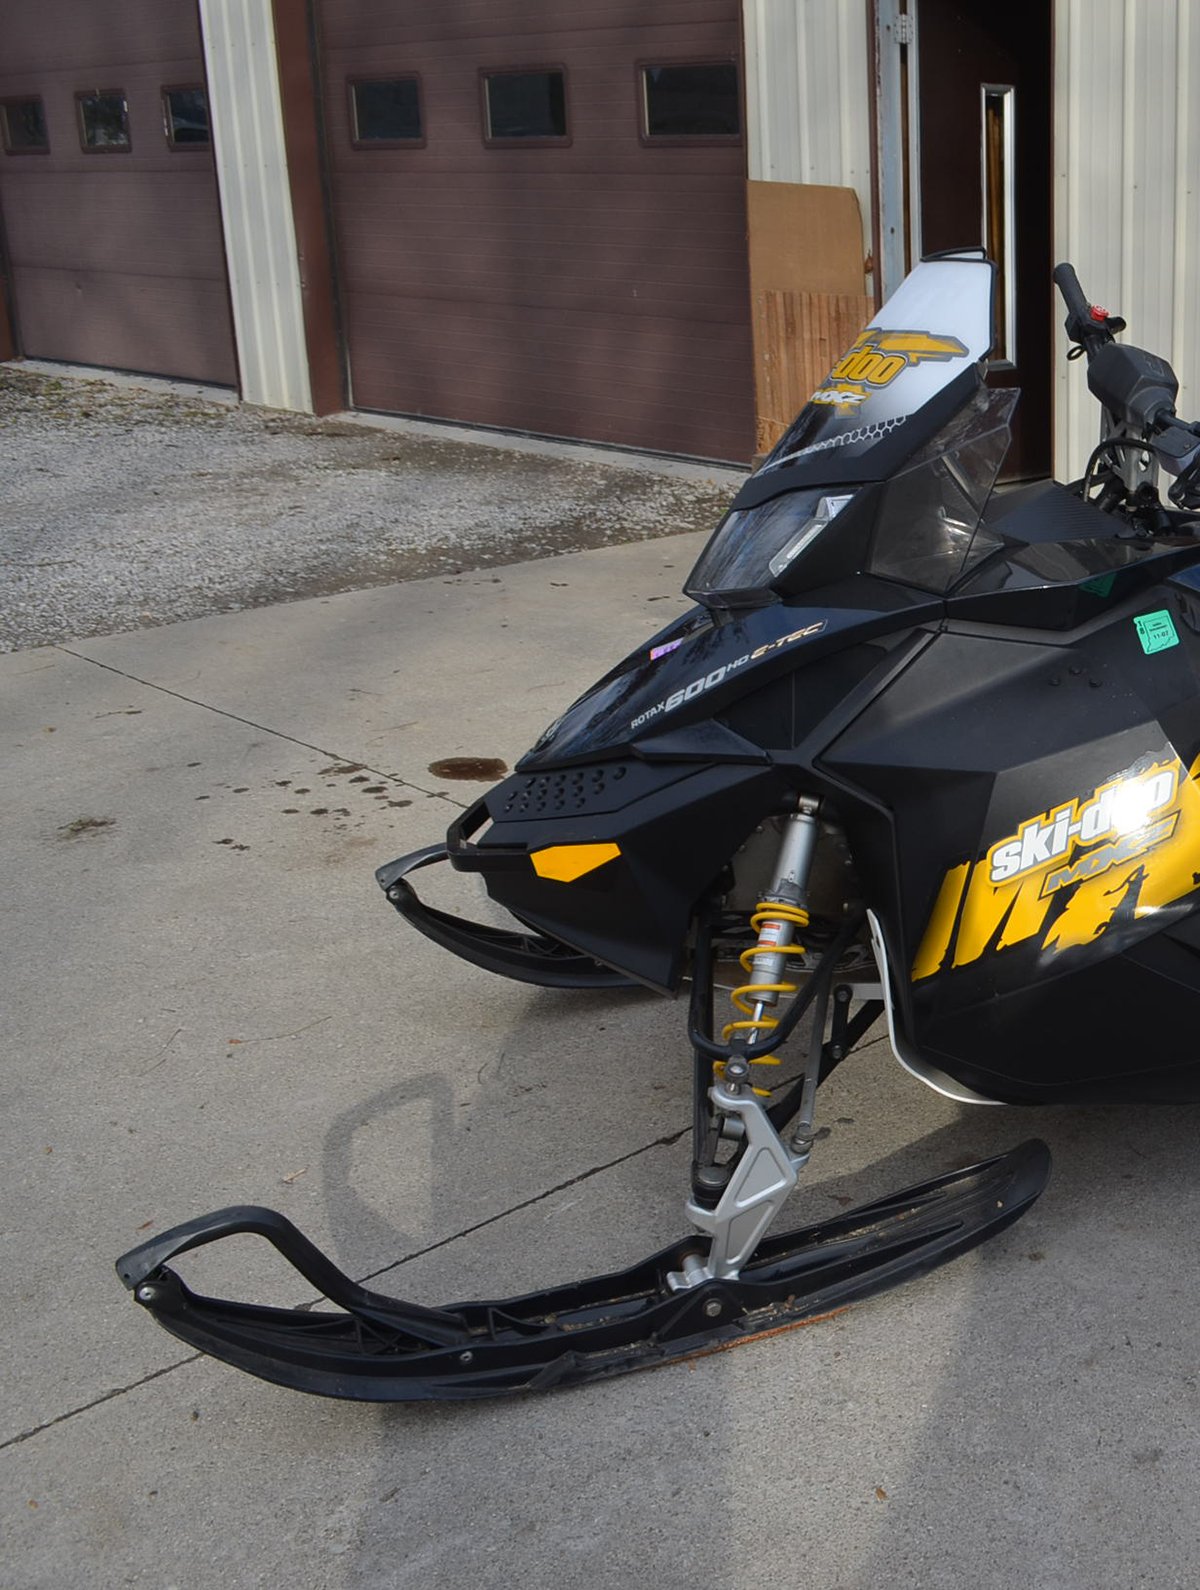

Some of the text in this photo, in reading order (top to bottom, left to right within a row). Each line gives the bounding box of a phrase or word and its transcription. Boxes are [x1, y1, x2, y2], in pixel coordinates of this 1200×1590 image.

[631, 701, 664, 729] ROTAX
[664, 666, 727, 712] 600
[989, 770, 1175, 883] ski-do
